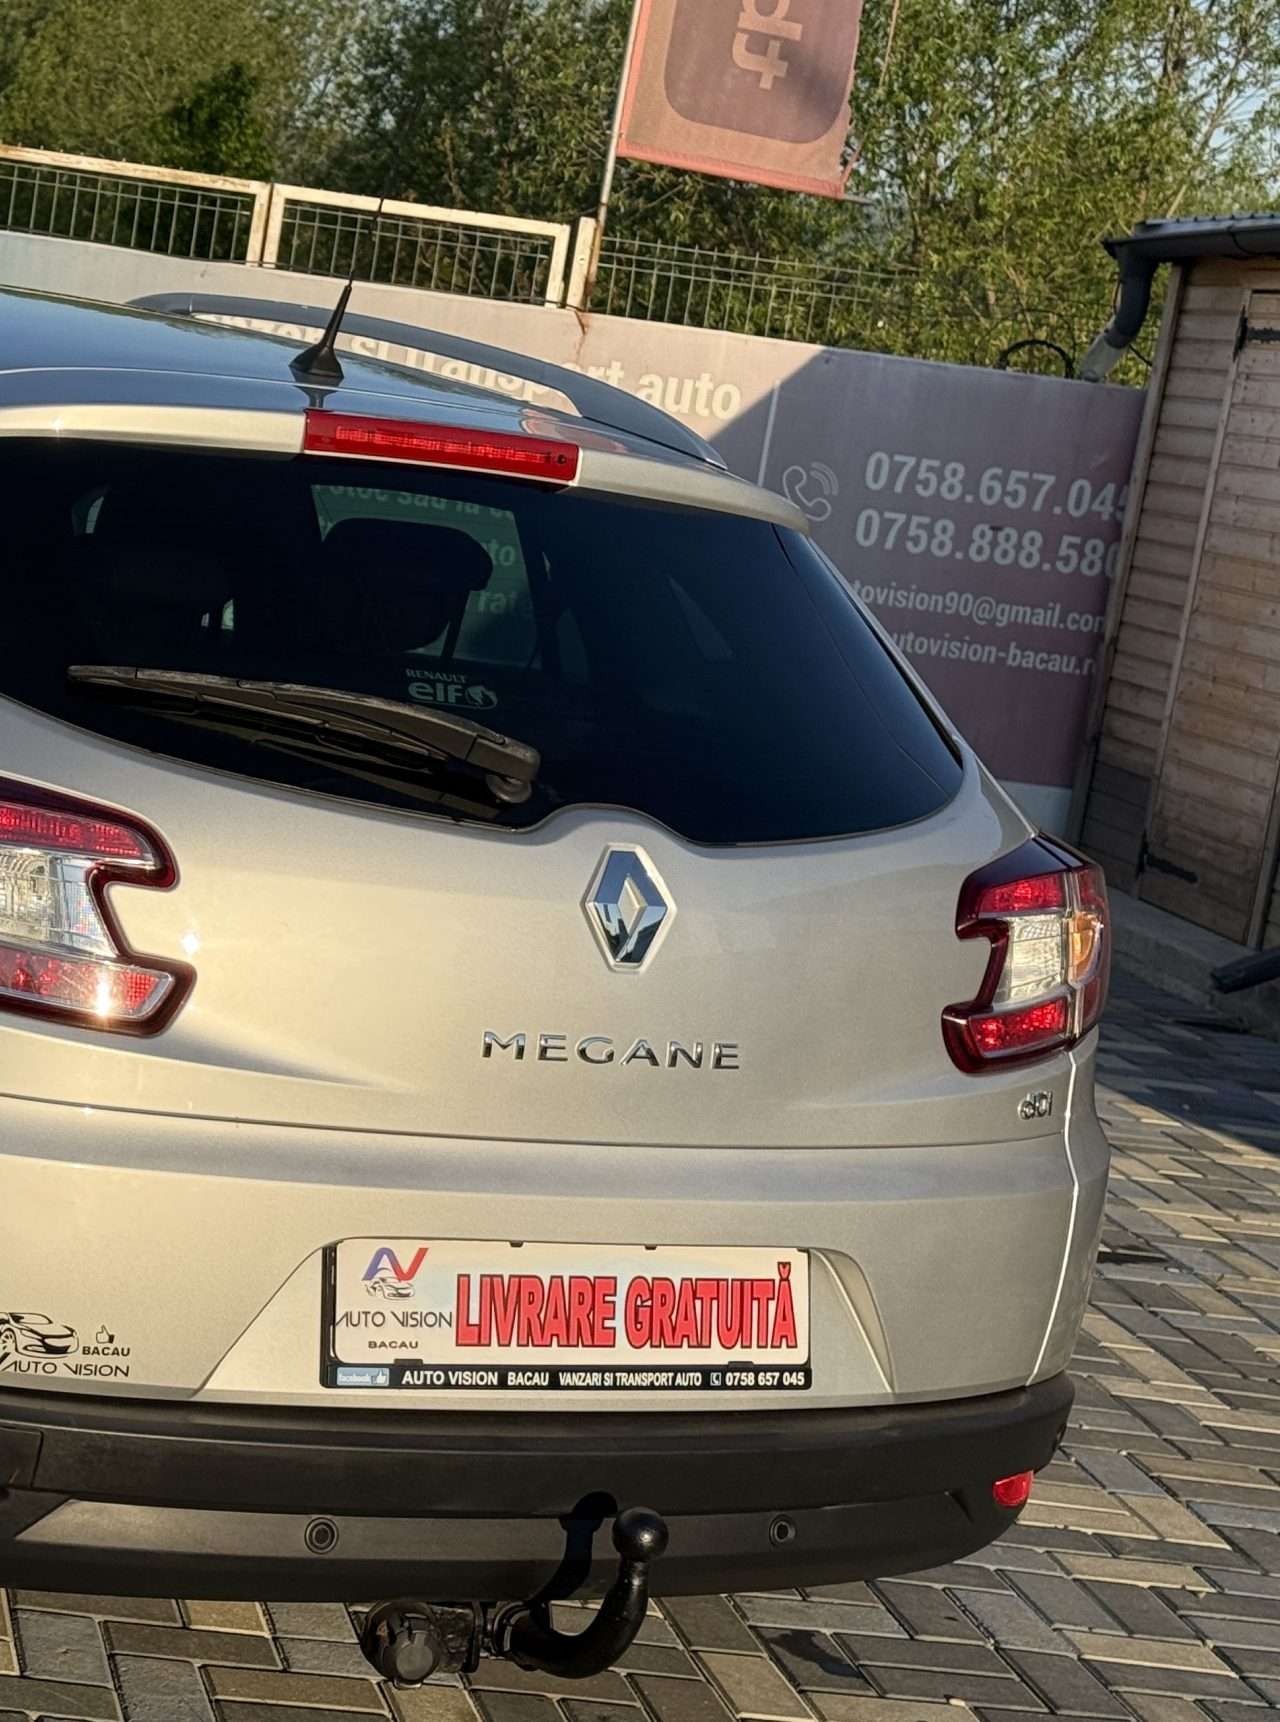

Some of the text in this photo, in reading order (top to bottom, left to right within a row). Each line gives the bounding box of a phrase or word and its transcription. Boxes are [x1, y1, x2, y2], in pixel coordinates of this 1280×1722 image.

[637, 372, 742, 420] auto
[405, 668, 467, 684] RENAULT
[481, 1030, 741, 1070] MEGANE
[455, 1261, 798, 1349] LIVRARE GRATUITĂ
[336, 1311, 452, 1328] AUTO VISION
[82, 1346, 131, 1357] BACAU
[368, 1340, 419, 1349] BACAU
[1, 1360, 130, 1377] AUTO VISION
[402, 1371, 805, 1387] AUTO VISION BACAU VANZARI SI TRANSPORT AUTO 0758 657 045
